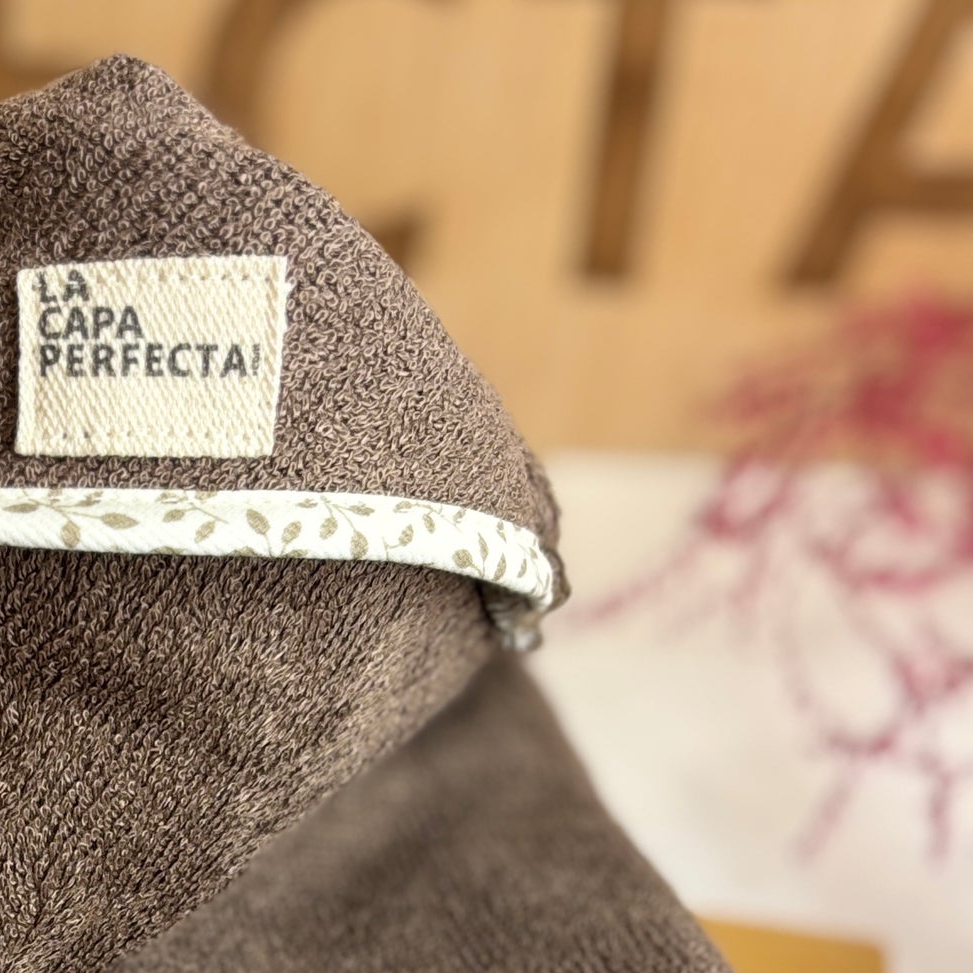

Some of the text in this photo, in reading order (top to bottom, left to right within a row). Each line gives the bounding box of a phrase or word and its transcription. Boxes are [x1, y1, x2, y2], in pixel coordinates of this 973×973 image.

[37, 269, 90, 302] LA
[38, 306, 143, 340] CAPA
[39, 343, 247, 378] PERFECTA
